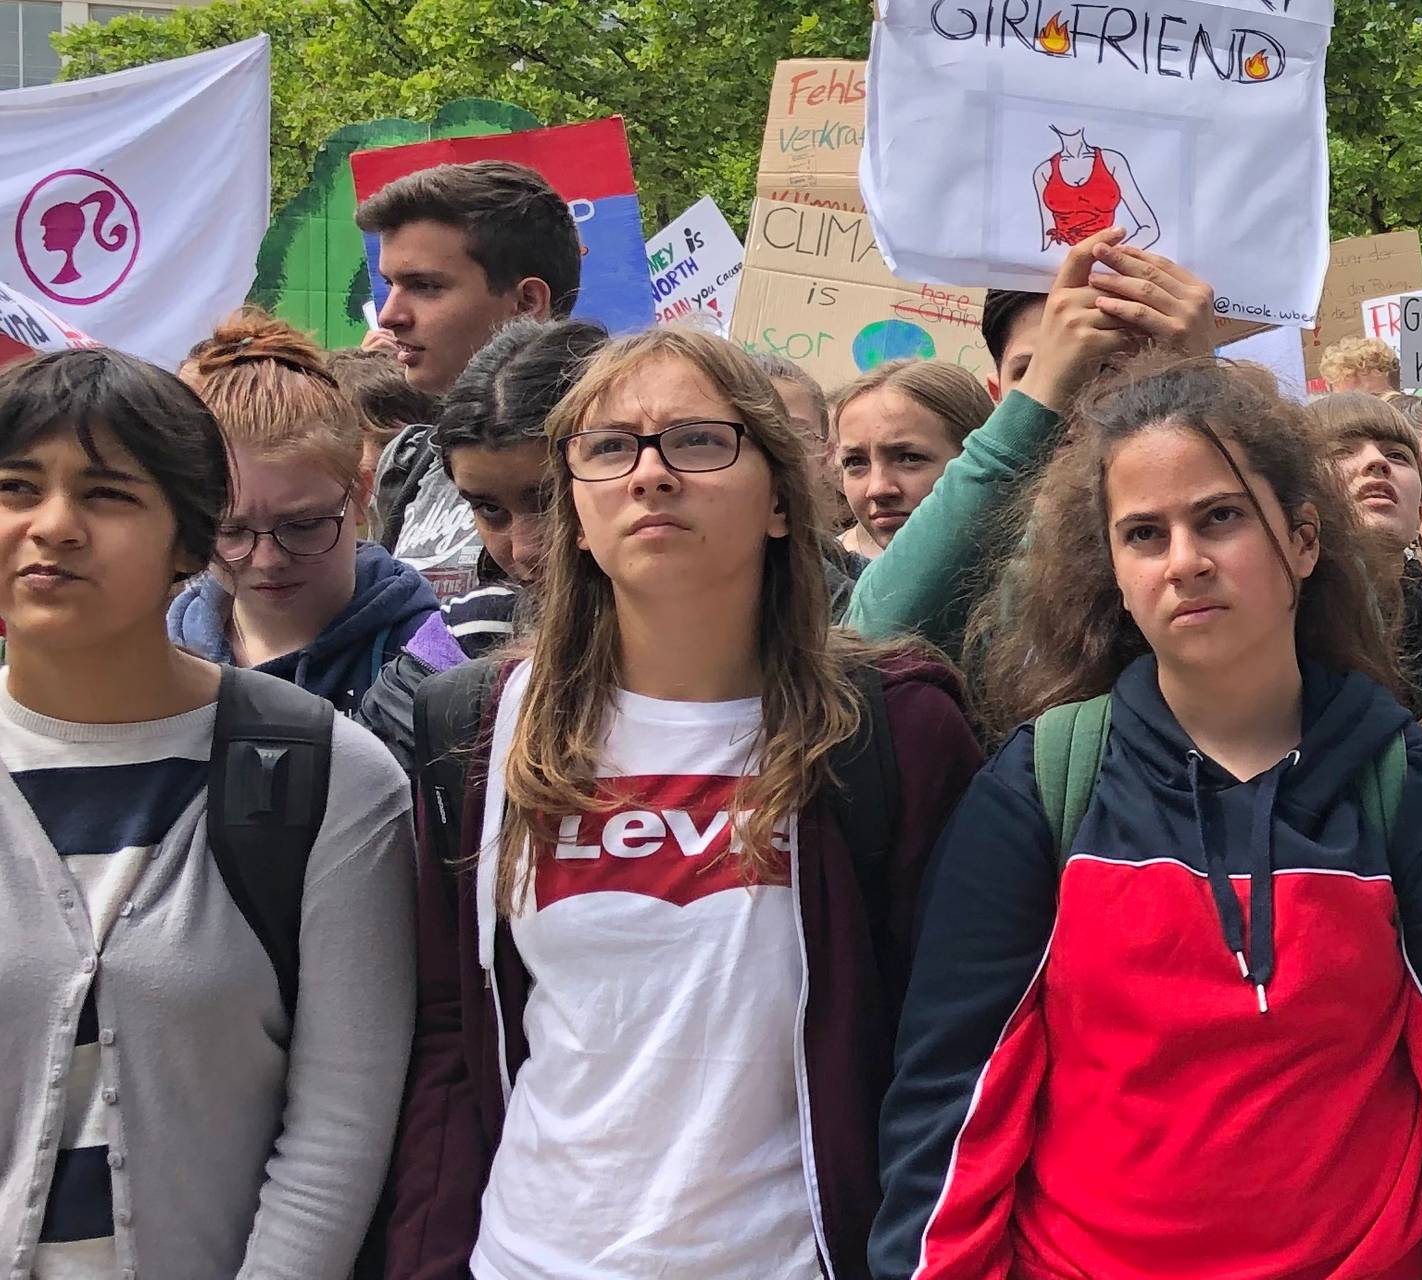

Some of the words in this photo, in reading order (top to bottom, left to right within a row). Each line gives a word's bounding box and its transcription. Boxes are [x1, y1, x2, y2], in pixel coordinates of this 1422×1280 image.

[763, 207, 887, 264] CLIMA
[806, 282, 839, 306] is
[921, 283, 969, 310] here
